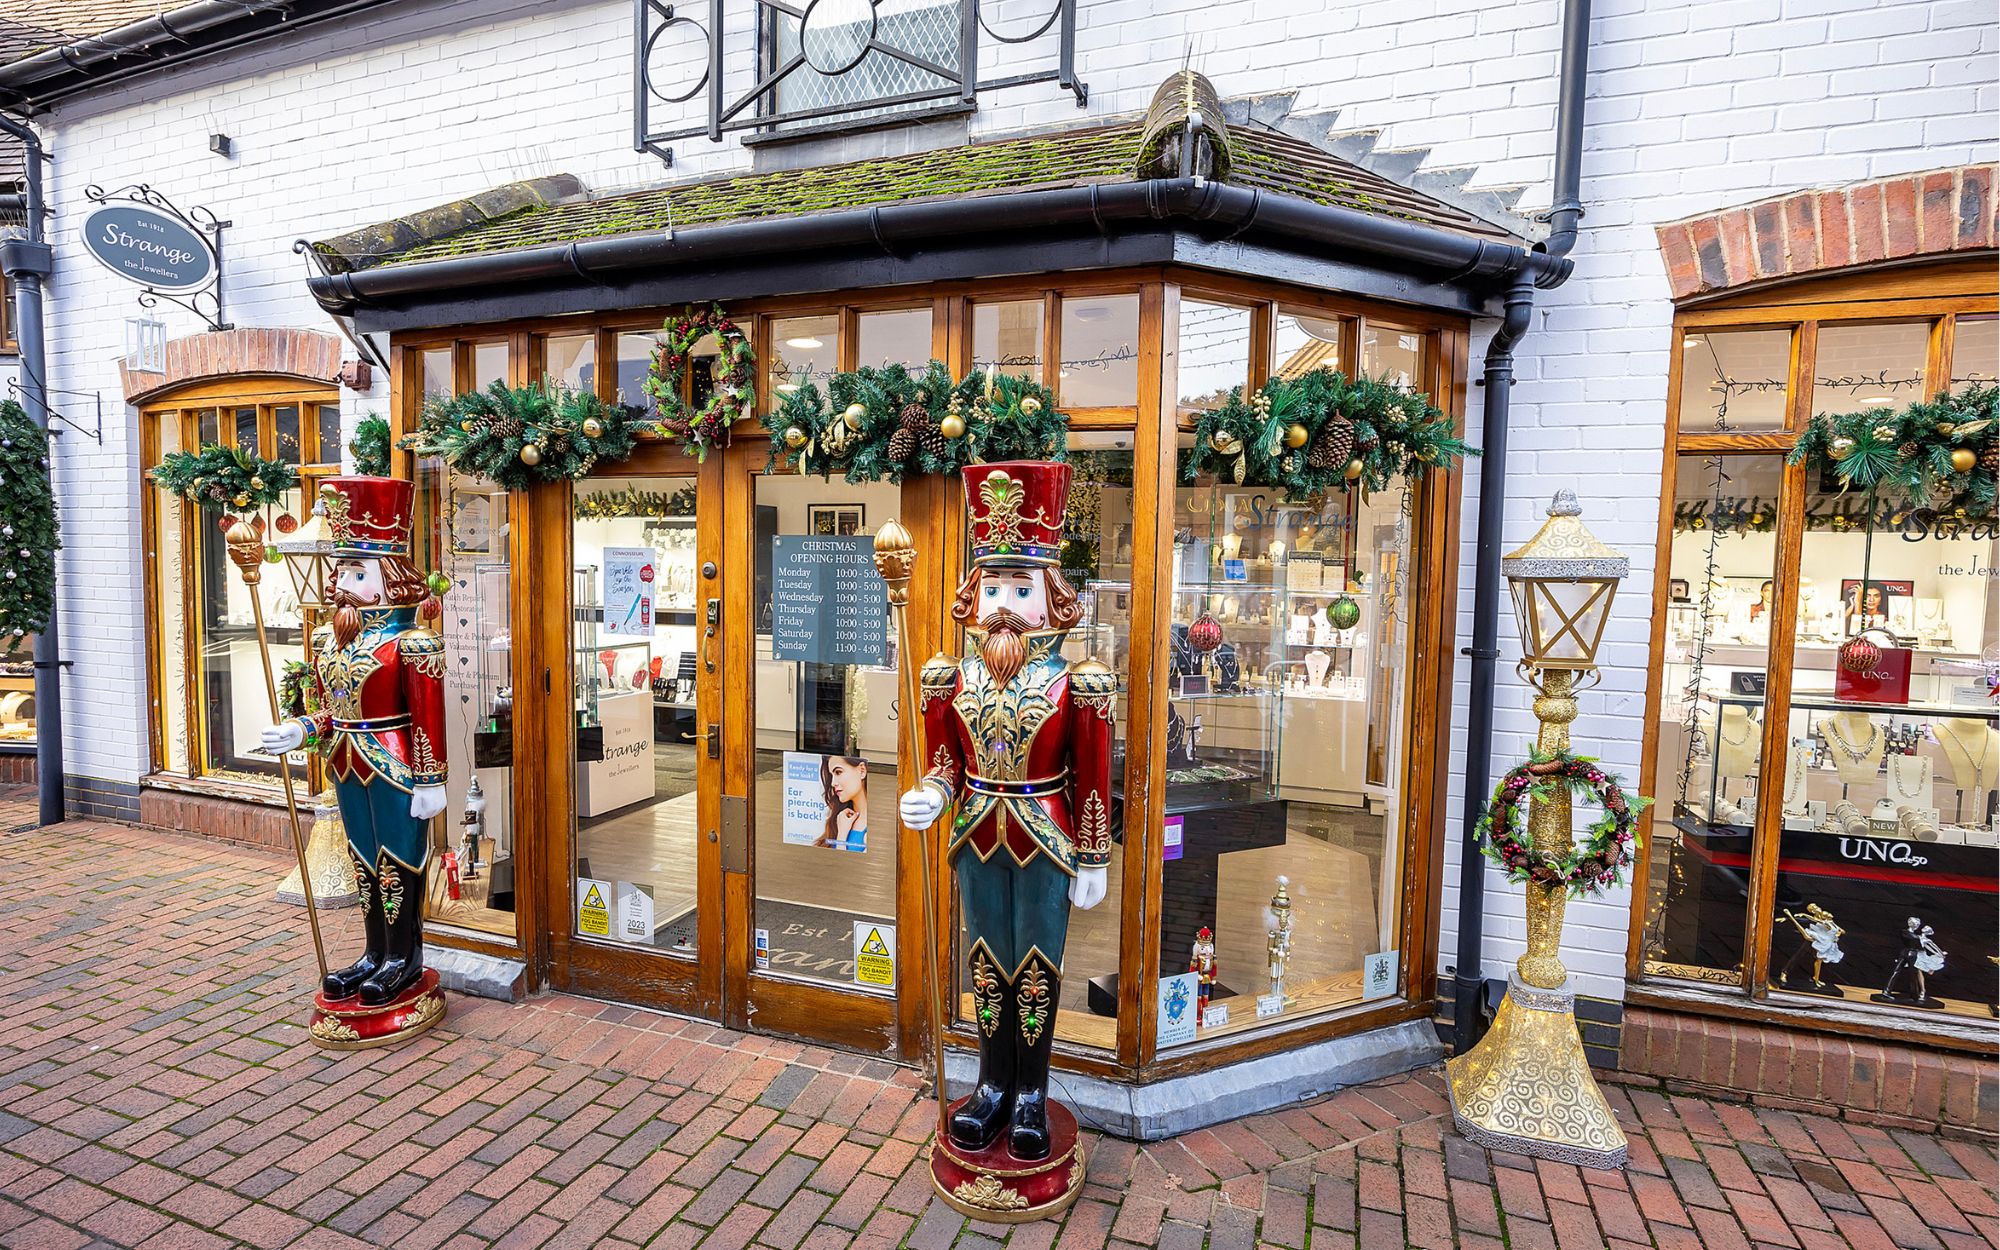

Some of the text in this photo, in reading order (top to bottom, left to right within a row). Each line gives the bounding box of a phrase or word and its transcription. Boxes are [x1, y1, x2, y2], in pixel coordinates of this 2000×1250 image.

[137, 220, 147, 228] Est
[102, 223, 195, 265] Strange
[124, 257, 179, 280] the Jewellers
[1249, 494, 1357, 533] Strange
[802, 541, 857, 552] CHRISTMAS
[790, 553, 869, 564] OPENING HOURS
[778, 567, 811, 579] Monday
[836, 568, 858, 579] 10:00
[864, 569, 881, 579] 5:00
[1939, 564, 1964, 576] the
[778, 579, 813, 591] Tuesday
[836, 581, 858, 591] 10:00
[864, 582, 881, 592] 5:00
[778, 591, 824, 604] Wednesday
[836, 593, 858, 603] 10:00
[864, 594, 881, 604] 5:00
[778, 603, 816, 615] Thursday
[836, 606, 858, 616] 10:00
[864, 606, 881, 617] 5:00
[778, 615, 804, 628] Friday
[836, 618, 858, 628] 10:00
[864, 619, 881, 629] 5:00
[464, 632, 471, 641] &
[778, 628, 814, 640] Saturday
[836, 631, 858, 641] 10:00
[864, 631, 881, 642] 5:00
[778, 640, 808, 652] Sunday
[835, 643, 857, 653] 11:00
[863, 644, 881, 654] 4:00
[465, 671, 472, 679] &
[788, 787, 802, 796] Ear
[788, 798, 825, 811] piercing
[788, 809, 822, 821] is back!
[1873, 822, 1896, 830] NEW
[627, 919, 645, 929] 2023
[782, 923, 829, 938] Est
[861, 956, 890, 965] WARNING
[872, 968, 891, 976] BANDIT
